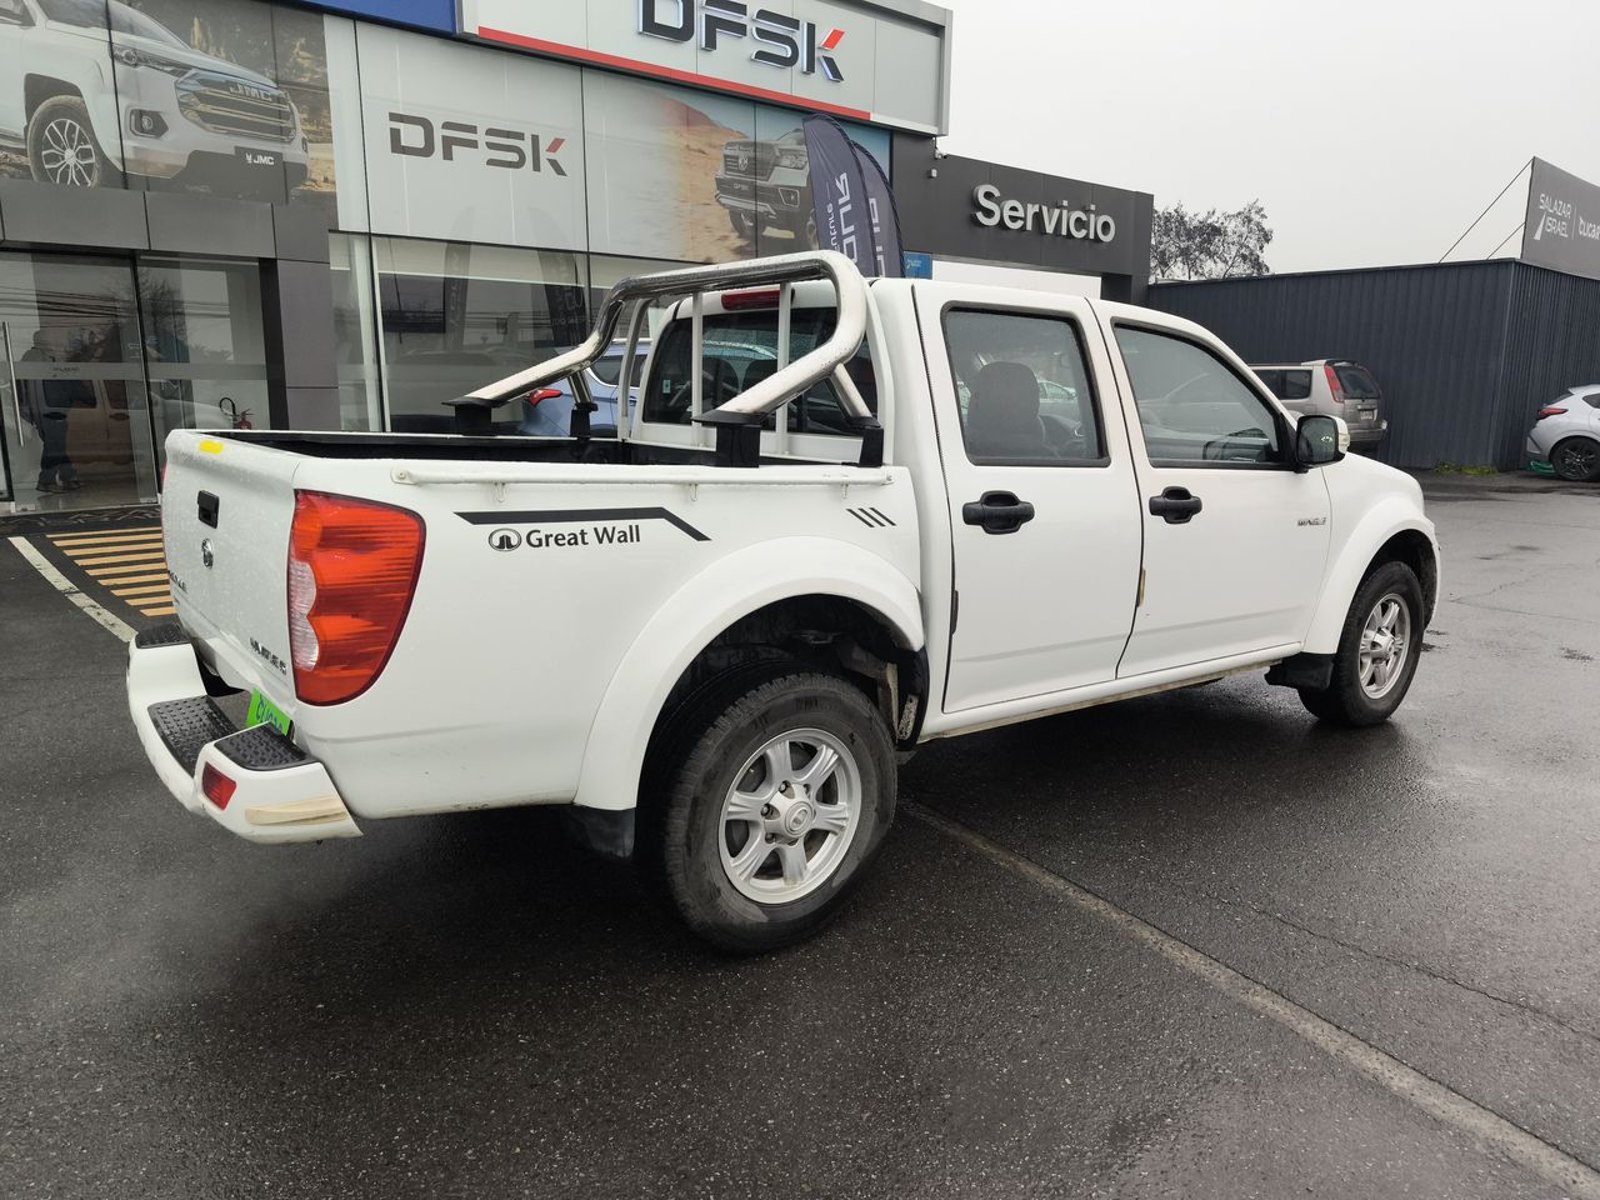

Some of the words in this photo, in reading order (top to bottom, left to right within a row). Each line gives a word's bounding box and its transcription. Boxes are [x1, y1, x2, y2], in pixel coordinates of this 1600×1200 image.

[638, 0, 846, 83] DFSK
[388, 112, 568, 177] DFSK
[974, 183, 1116, 243] Servicio
[526, 529, 589, 548] Great
[594, 524, 641, 545] Wall
